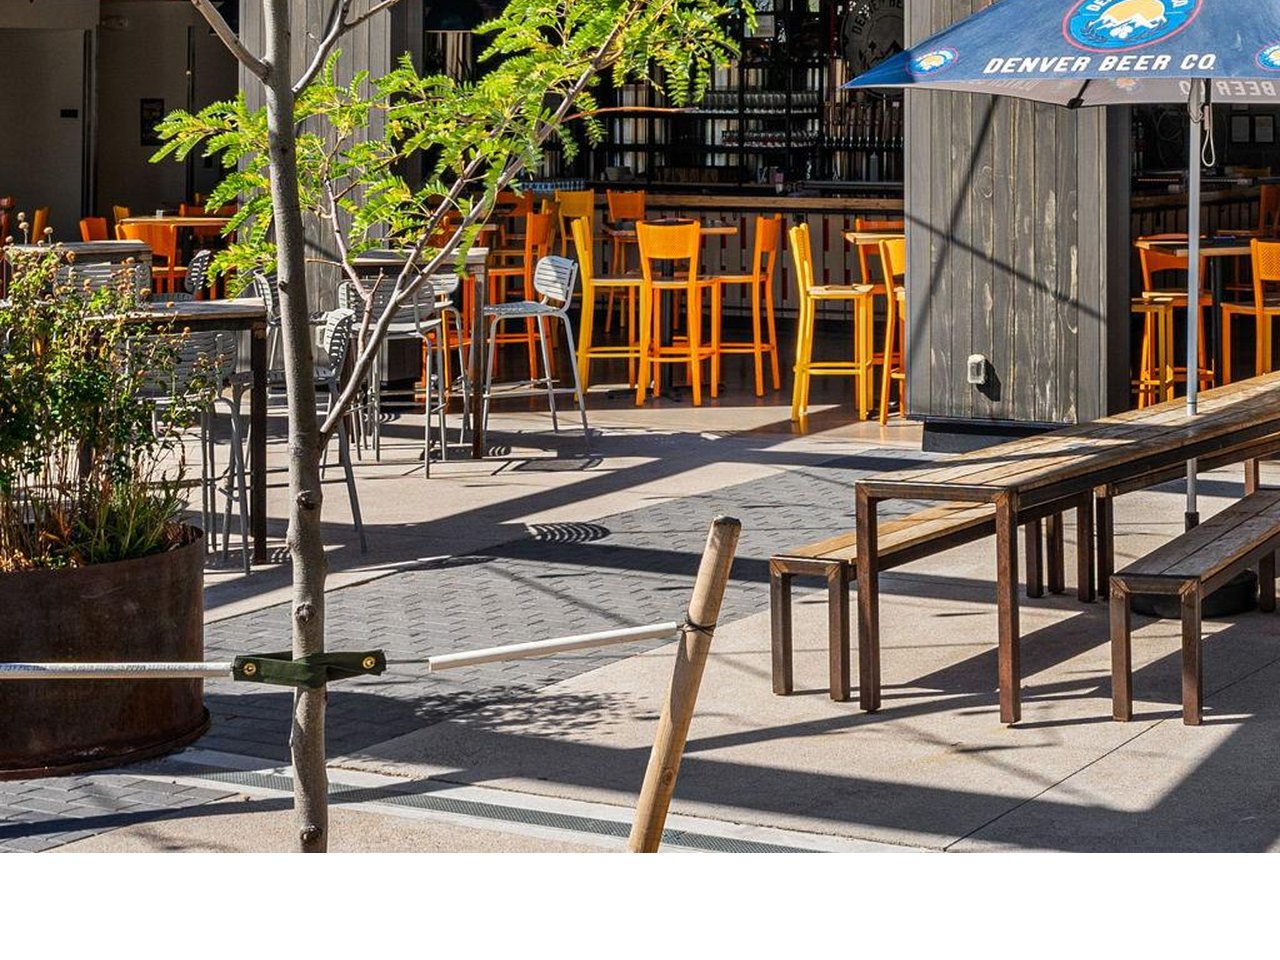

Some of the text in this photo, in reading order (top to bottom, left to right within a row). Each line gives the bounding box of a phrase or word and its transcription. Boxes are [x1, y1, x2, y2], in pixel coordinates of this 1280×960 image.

[983, 53, 1217, 74] DENVER BEER CO.
